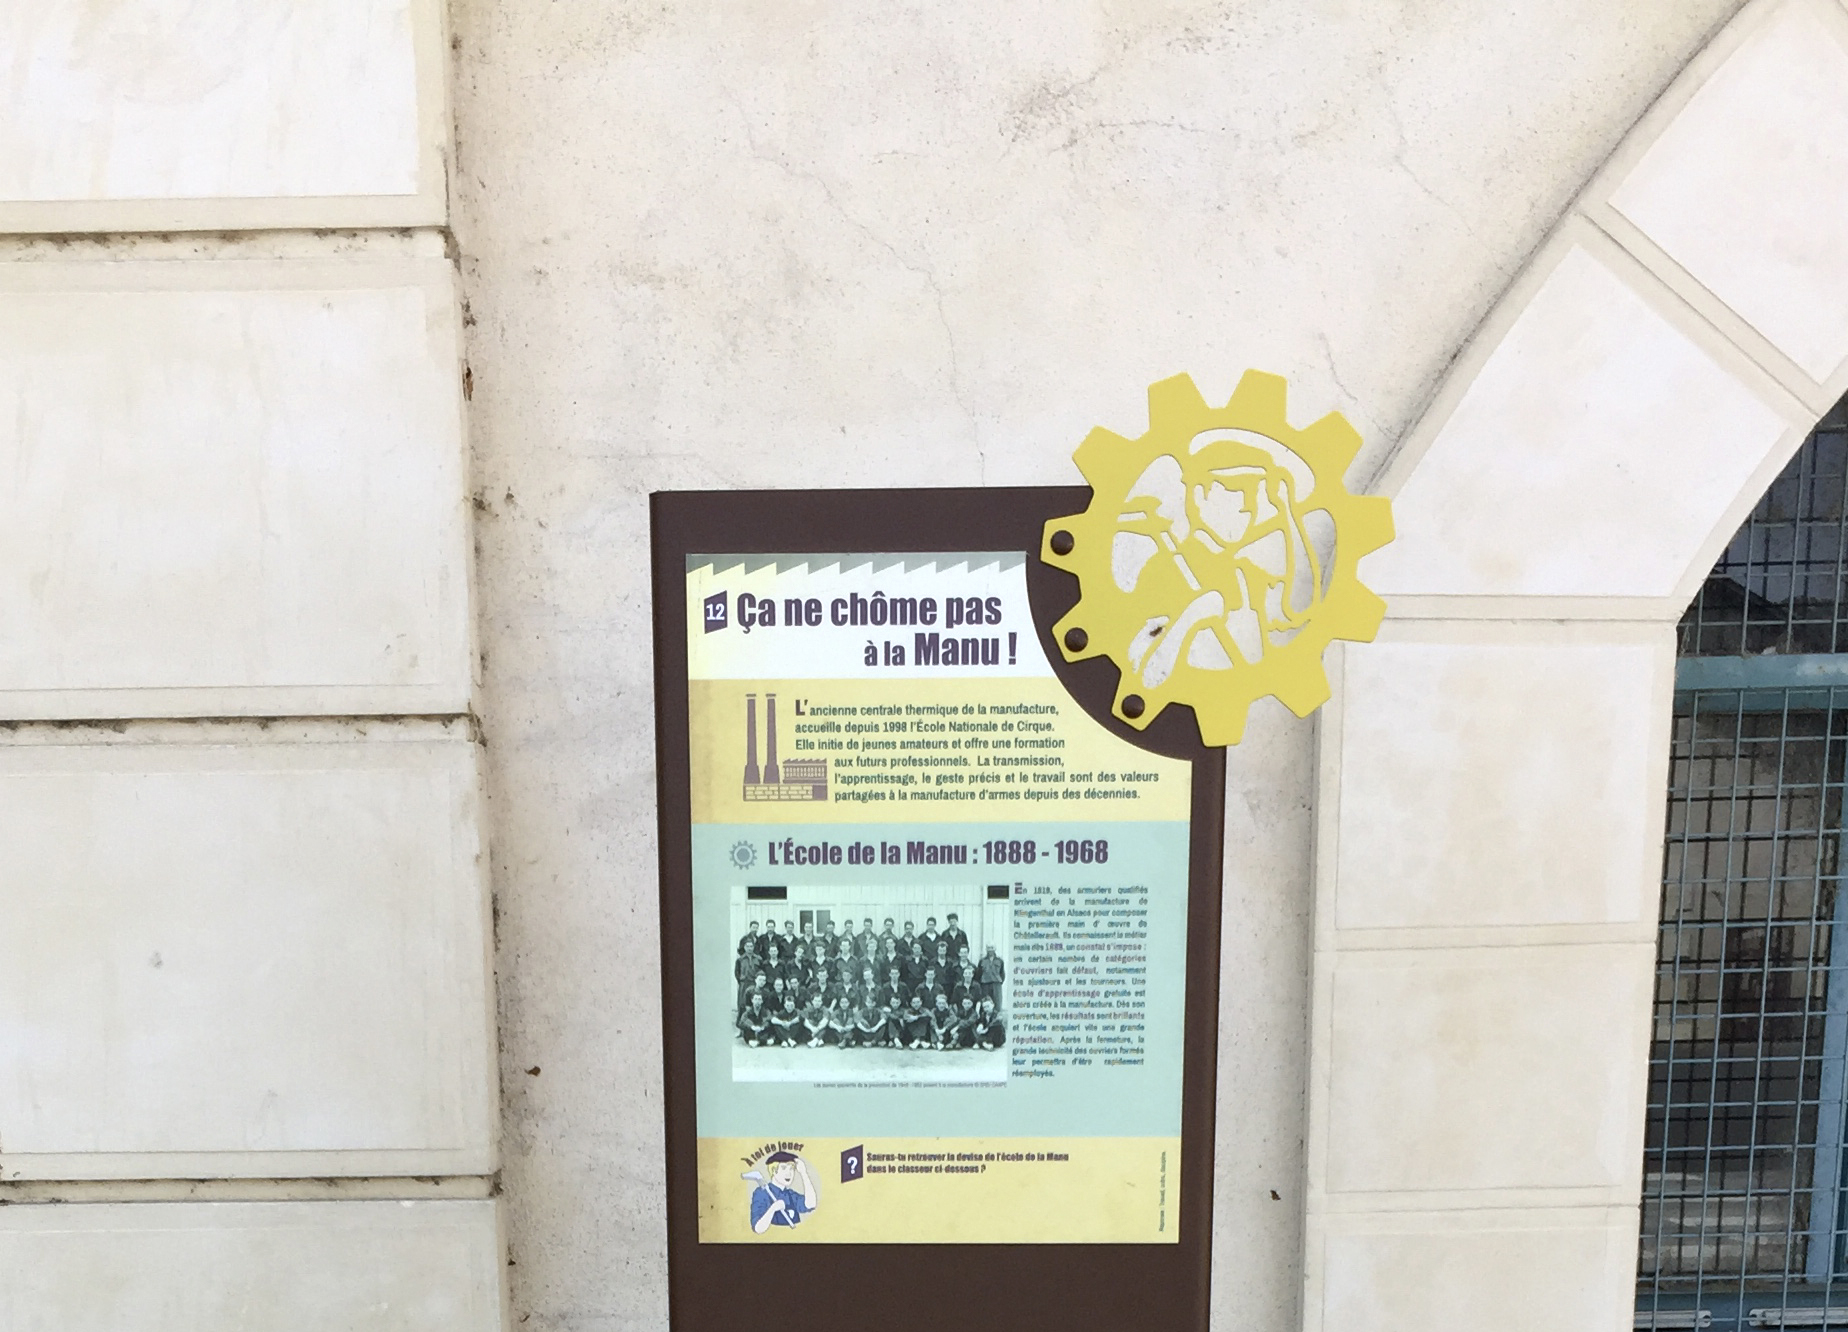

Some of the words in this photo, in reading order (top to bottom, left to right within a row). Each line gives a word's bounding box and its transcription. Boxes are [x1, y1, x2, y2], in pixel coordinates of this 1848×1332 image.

[706, 603, 725, 620] 12
[737, 592, 775, 633] Ça
[784, 598, 822, 626] ne
[830, 590, 937, 626] chôme
[946, 597, 1001, 628] pas
[864, 640, 877, 666] à
[884, 641, 905, 666] la
[914, 632, 999, 665] Manu
[860, 704, 902, 715] centrale
[905, 703, 958, 718] thermique
[962, 703, 974, 714] de
[978, 703, 986, 714] la
[990, 703, 1058, 715] manufacture,
[795, 721, 841, 732] accueille
[844, 721, 879, 734] depuis
[883, 721, 906, 732] 1998
[910, 719, 945, 732] l'École
[948, 721, 998, 731] Nationale
[1001, 720, 1014, 731] de
[1016, 720, 1054, 733] Cirque.
[795, 738, 814, 750] Elle
[818, 738, 843, 749] initie
[846, 738, 858, 749] de
[861, 738, 896, 752] jeunes
[900, 738, 948, 749] amateurs
[951, 738, 961, 748] et
[964, 737, 988, 748] offre
[992, 740, 1011, 748] une
[1014, 737, 1064, 748] formation
[834, 758, 853, 767] aux
[856, 755, 886, 767] futurs
[890, 755, 970, 768] professionnels.
[977, 755, 990, 766] La
[992, 755, 1064, 767] transmission,
[834, 772, 917, 786] l'apprentissage,
[922, 772, 931, 783] le
[935, 773, 964, 785] geste
[968, 771, 1000, 785] précis
[1005, 772, 1014, 782] et
[1019, 771, 1028, 782] le
[1032, 771, 1065, 782] travail
[1070, 772, 1092, 782] sont
[1097, 771, 1116, 782] des
[1120, 771, 1158, 781] valeurs
[834, 789, 886, 803] partagées
[888, 789, 894, 800] à
[898, 789, 907, 800] la
[910, 789, 975, 800] manufacture
[978, 788, 1020, 799] d'armes
[1024, 788, 1058, 801] depuis
[1062, 787, 1080, 799] des
[1084, 787, 1140, 799] décennies.
[768, 837, 842, 865] L'École
[848, 841, 874, 864] de
[880, 841, 900, 864] la
[906, 841, 966, 864] Manu
[982, 840, 1036, 864] 1888
[1054, 840, 1108, 864] 1968
[778, 1141, 804, 1152] jouer
